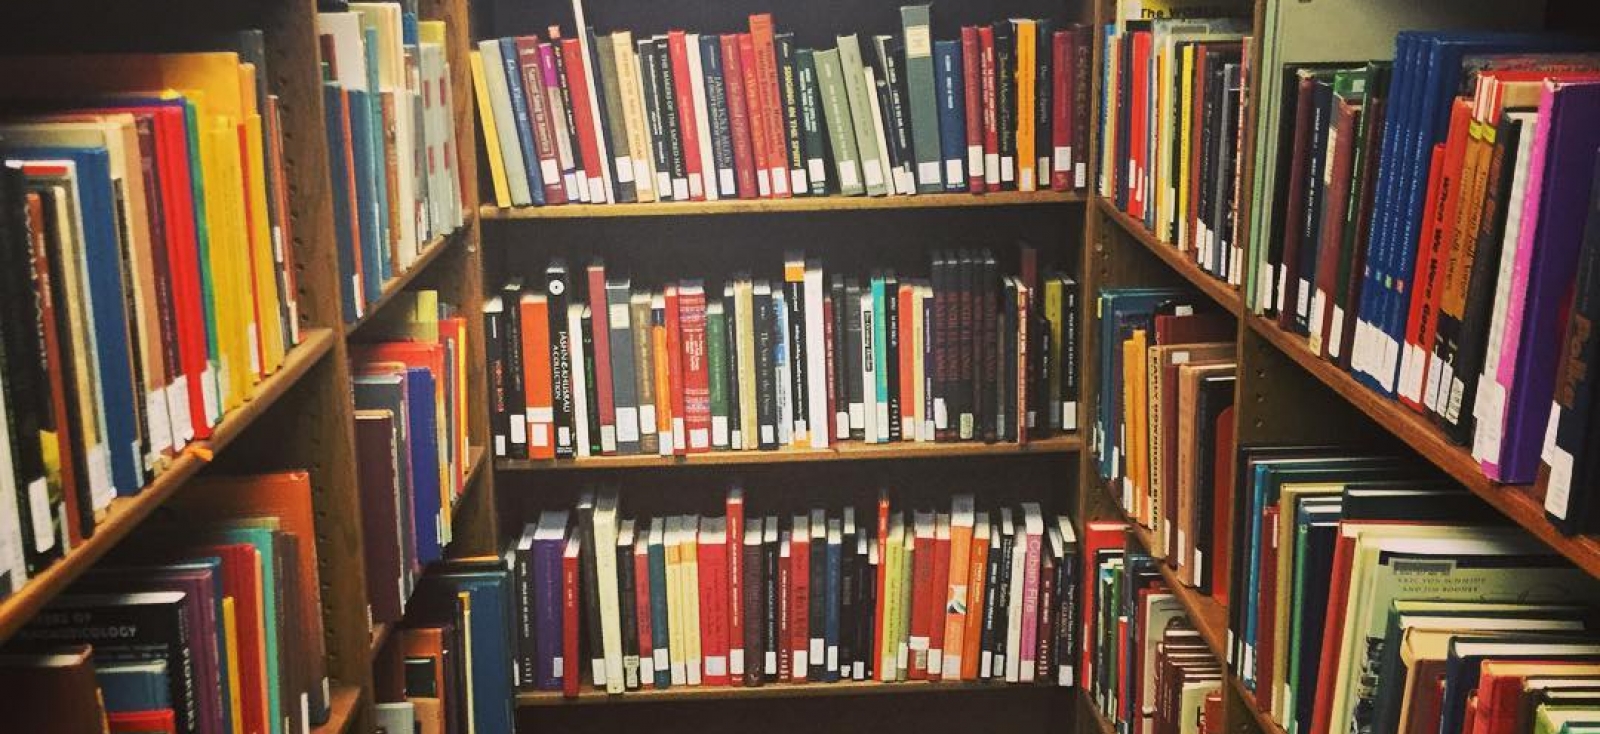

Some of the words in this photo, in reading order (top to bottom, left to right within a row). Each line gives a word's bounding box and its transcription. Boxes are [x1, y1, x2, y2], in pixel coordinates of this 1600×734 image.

[1140, 8, 1164, 19] The
[1436, 176, 1451, 222] When
[1432, 227, 1443, 253] We
[1425, 258, 1440, 299] Were
[1420, 302, 1432, 346] Good
[1028, 539, 1040, 583] Cuban
[1026, 587, 1038, 613] Fire
